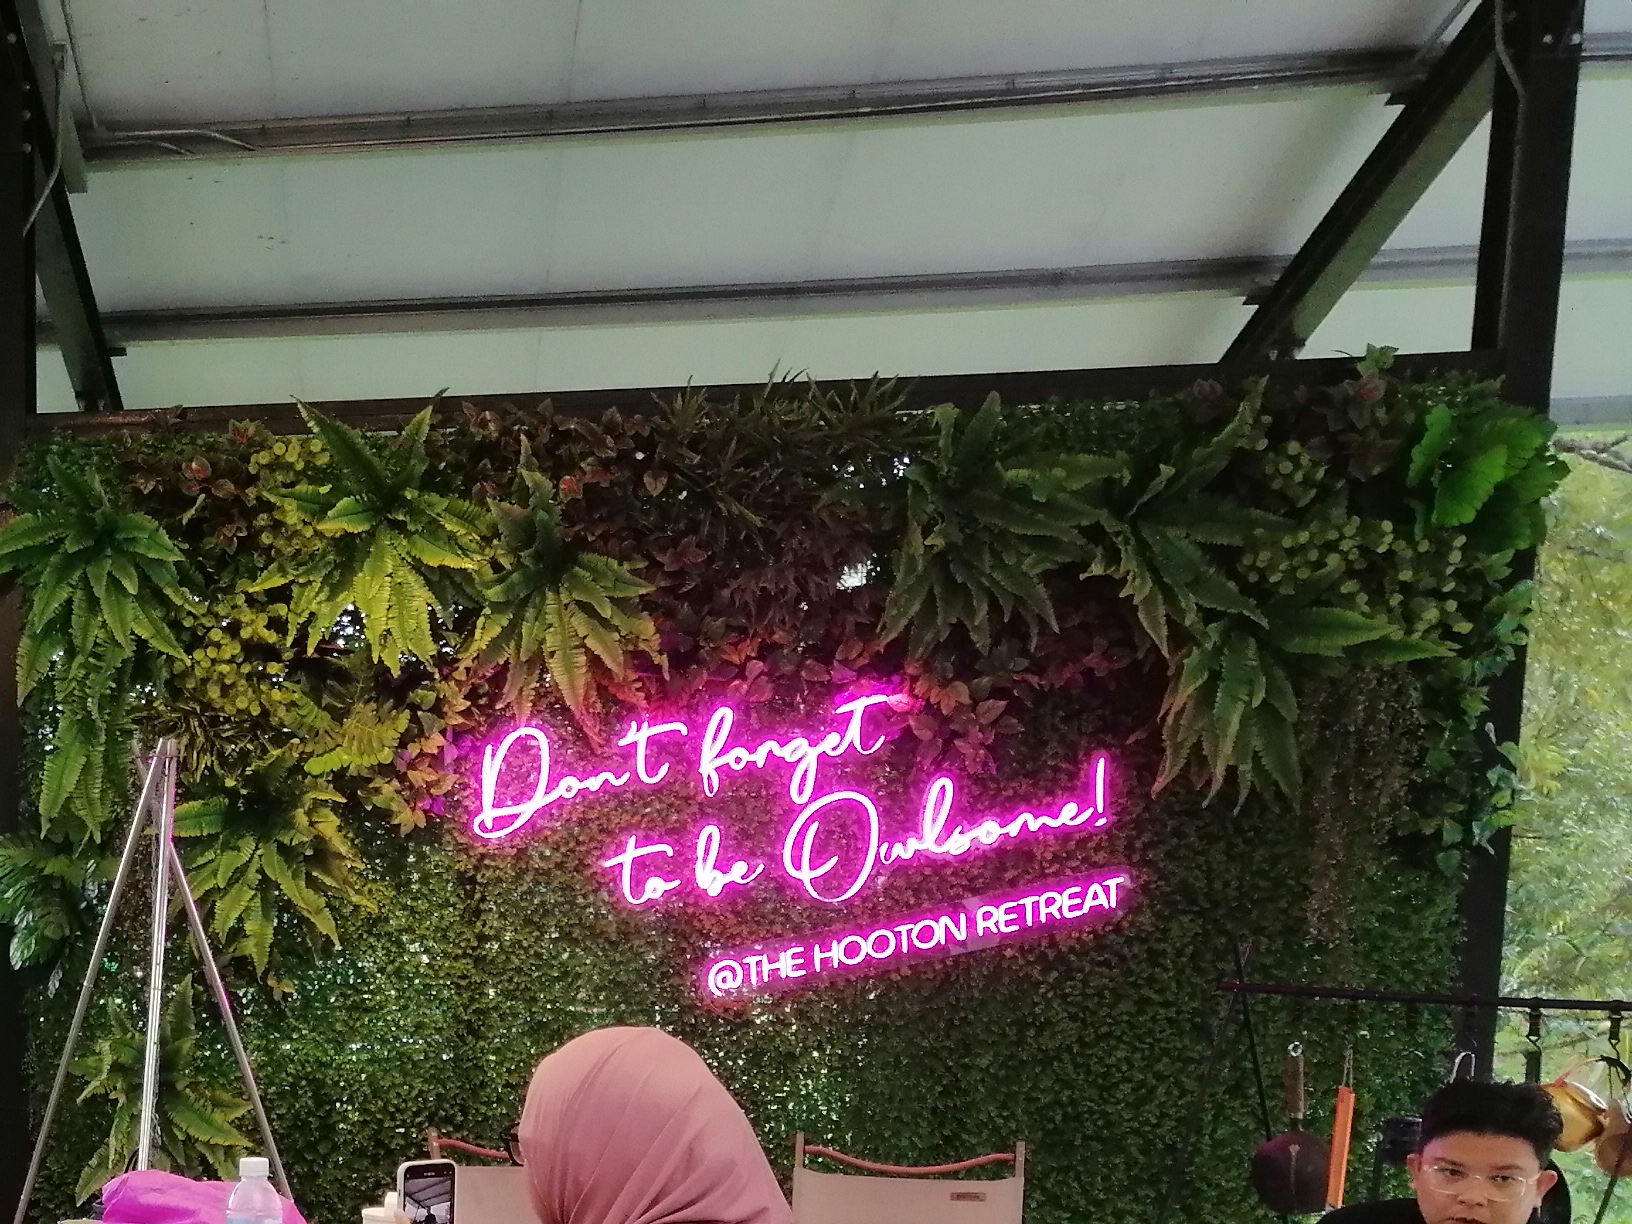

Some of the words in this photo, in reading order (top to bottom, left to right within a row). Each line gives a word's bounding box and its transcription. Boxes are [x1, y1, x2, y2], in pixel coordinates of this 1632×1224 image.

[473, 719, 688, 838] Don't
[698, 695, 891, 804] forget
[603, 835, 681, 904] to
[695, 824, 765, 896] be
[783, 757, 1108, 902] Owlsome!
[707, 946, 806, 996] @THE
[814, 911, 967, 973] HOOTON
[976, 876, 1125, 936] RETREAT
